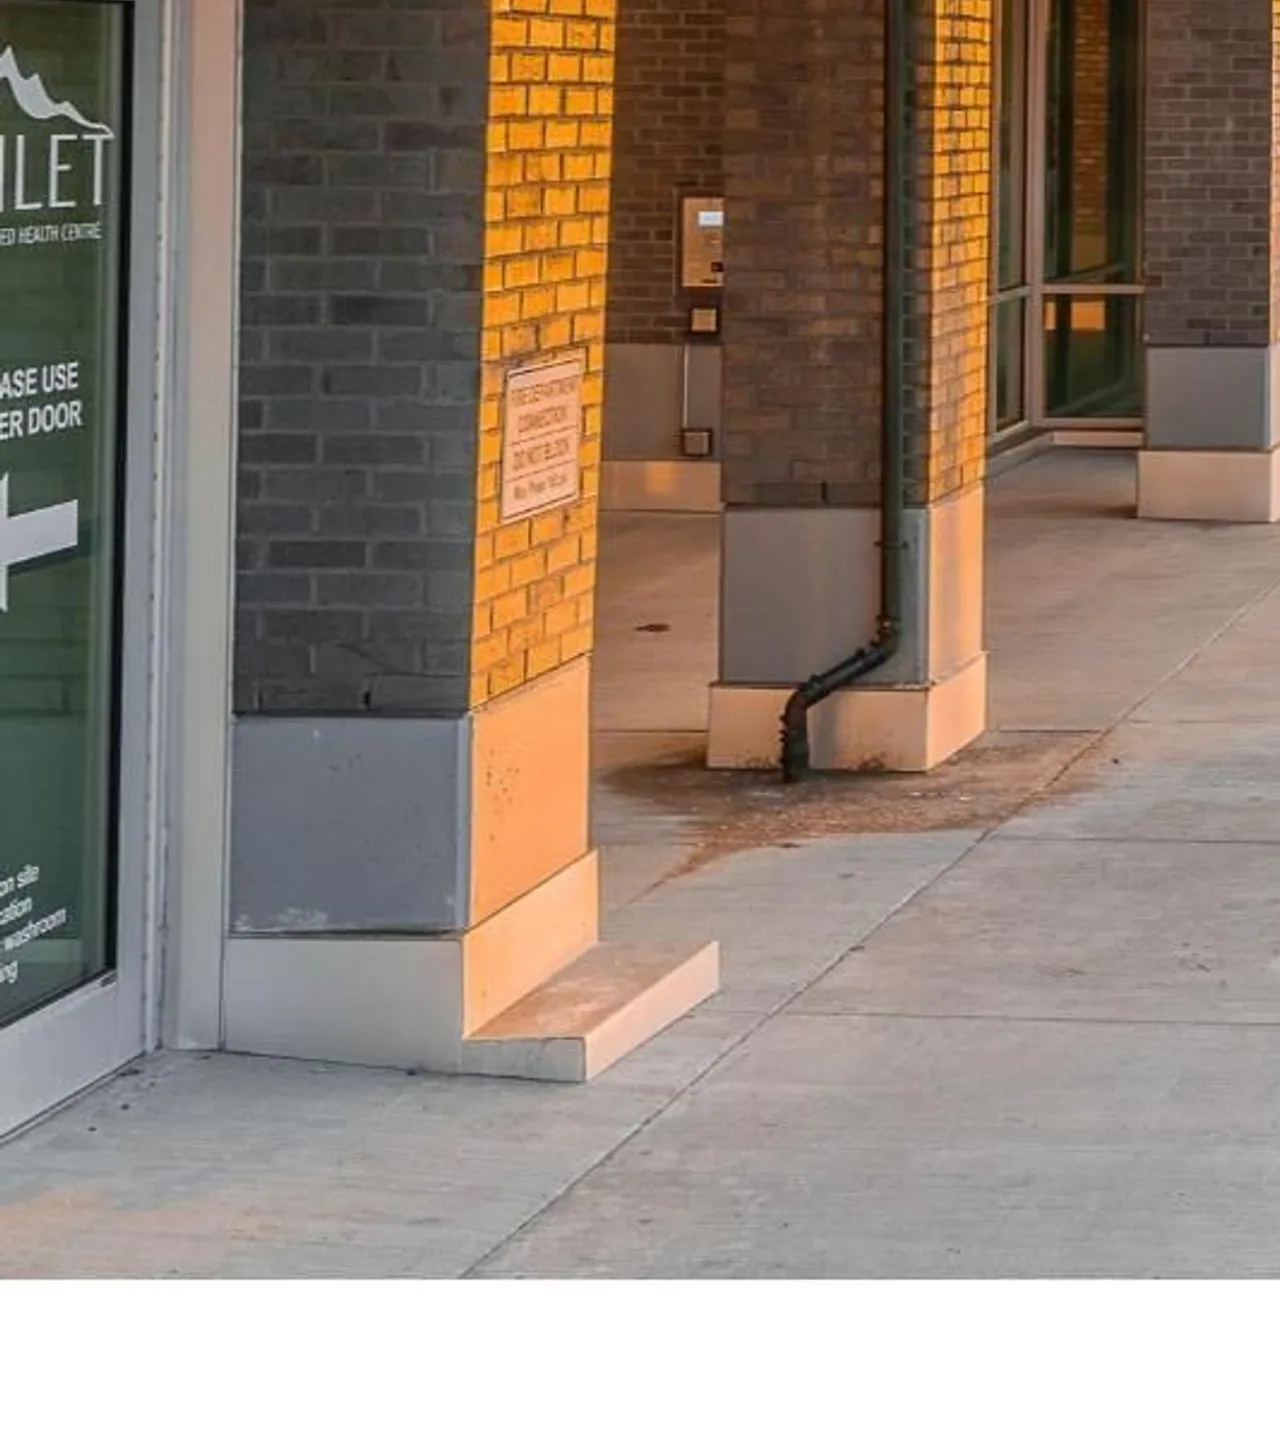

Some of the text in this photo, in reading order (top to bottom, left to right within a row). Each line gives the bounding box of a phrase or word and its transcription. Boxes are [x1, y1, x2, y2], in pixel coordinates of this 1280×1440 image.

[0, 134, 114, 213] LET
[18, 224, 60, 245] HEALTH
[61, 220, 102, 241] CENTRE
[0, 361, 79, 400] ASE USE
[28, 400, 84, 436] DOOR
